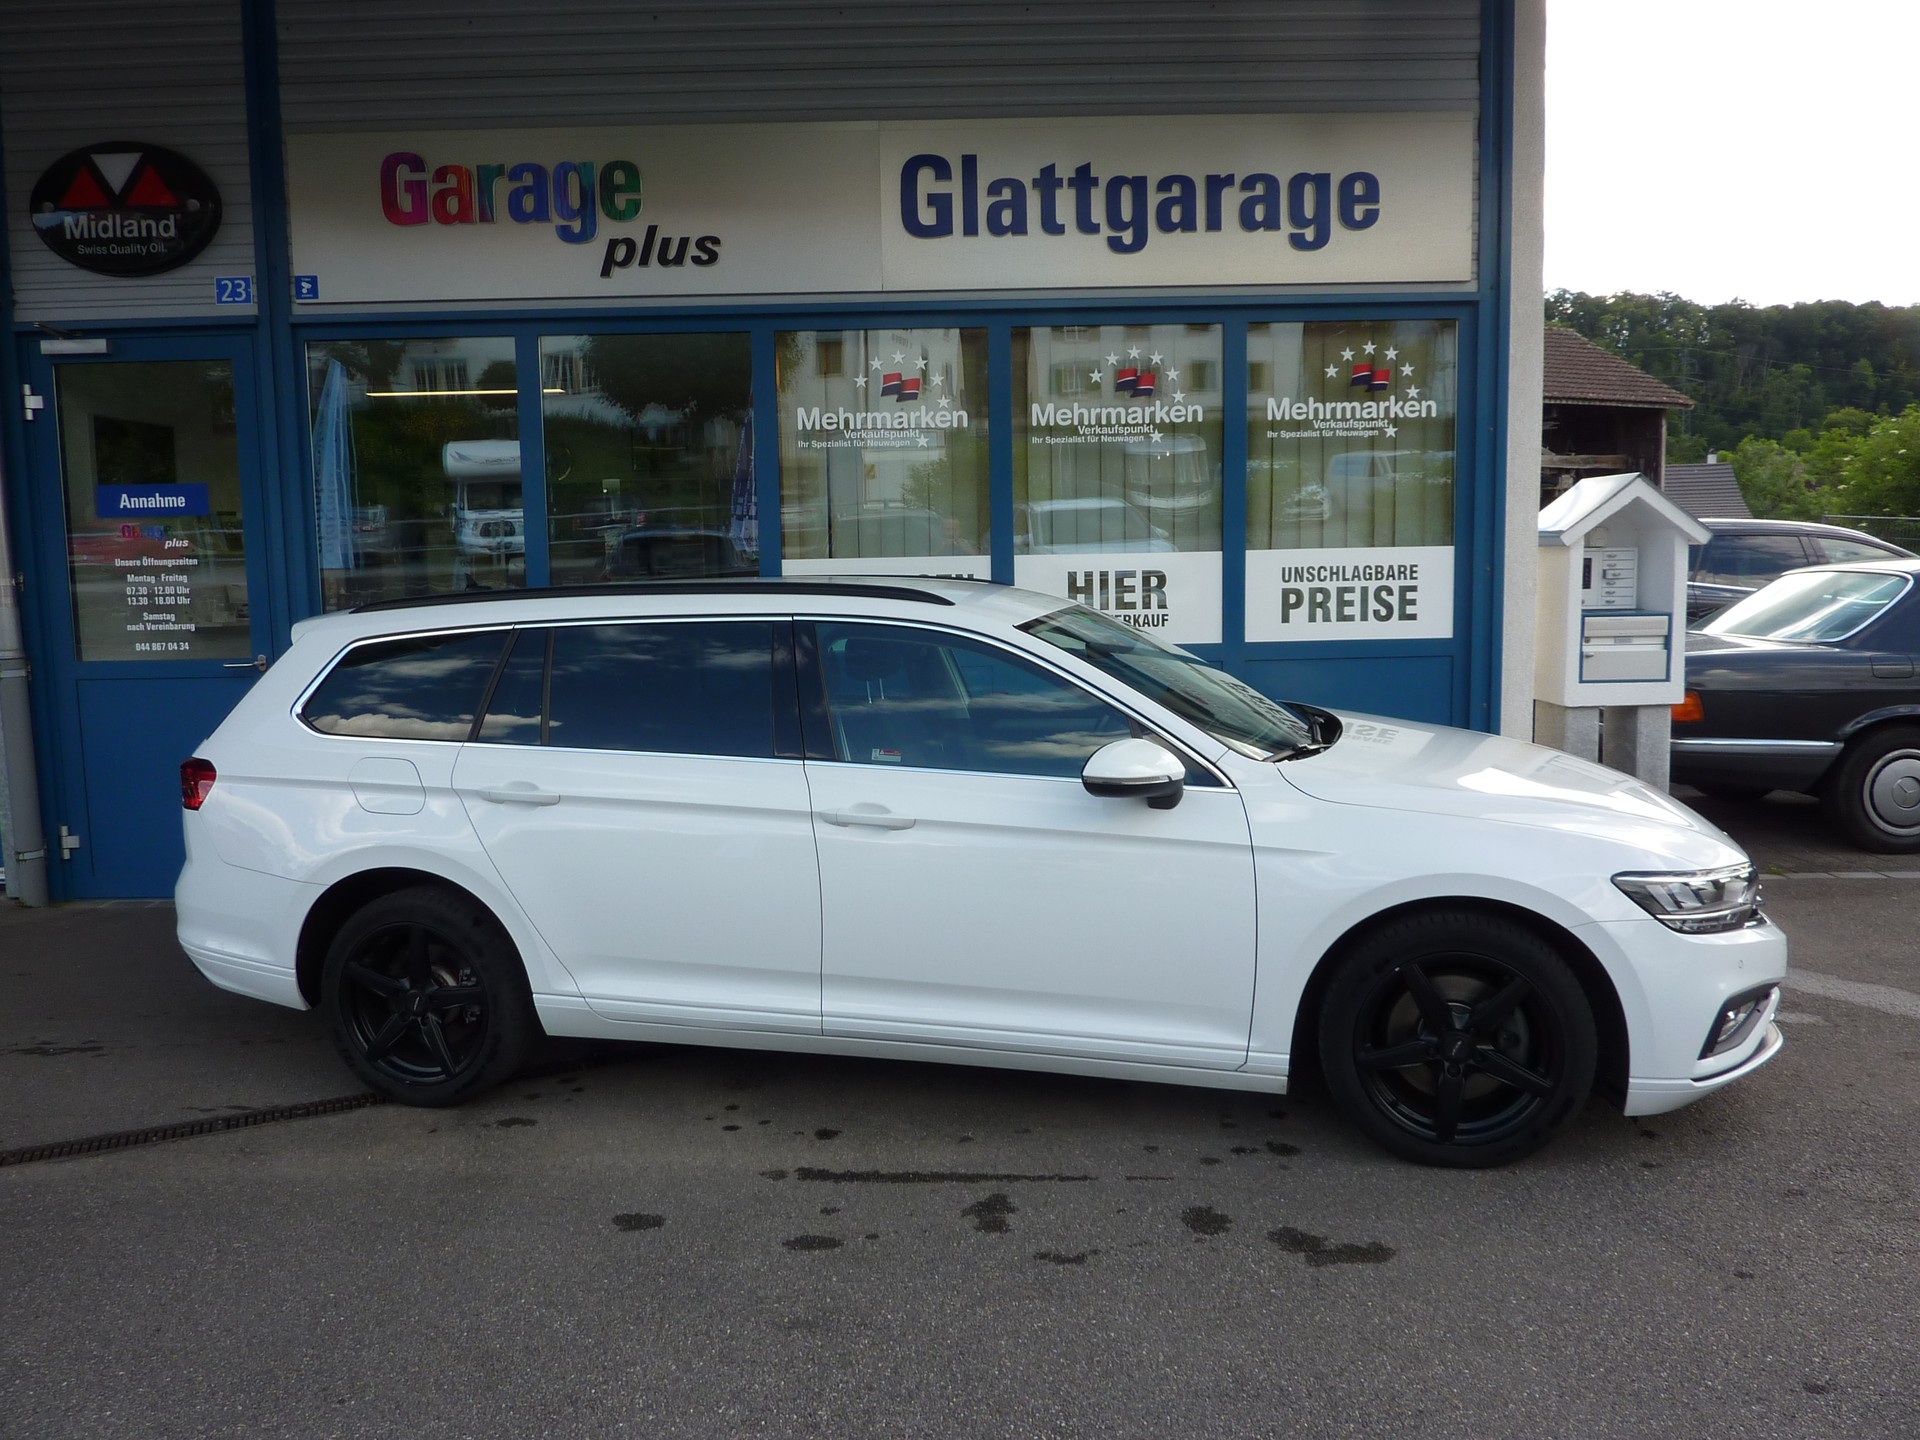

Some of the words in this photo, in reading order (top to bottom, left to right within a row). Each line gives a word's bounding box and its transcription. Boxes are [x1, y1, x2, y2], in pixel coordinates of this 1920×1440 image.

[380, 151, 643, 244] Garage
[899, 153, 1380, 254] Glattgarage
[63, 213, 176, 240] Midland
[77, 244, 108, 255] Swiss
[109, 243, 147, 255] Quality
[600, 224, 722, 279] plus
[221, 279, 247, 302] 23
[1031, 400, 1203, 426] Mehrmarken
[1266, 395, 1437, 421] Mehrmarken
[796, 405, 969, 431] Mehrmarken
[1313, 418, 1389, 430] Verkaufspunkt
[843, 429, 920, 440] Verkaufspunkt
[1077, 424, 1154, 435] Verkaufspunkt
[1267, 430, 1279, 438] Ihr
[1280, 430, 1321, 439] Spezialist
[1322, 429, 1334, 437] für
[1336, 429, 1379, 438] Neuwagen
[798, 440, 810, 448] Ihr
[811, 440, 852, 449] Spezialist
[853, 439, 865, 447] für
[867, 439, 910, 448] Neuwagen
[1031, 436, 1043, 444] Ihr
[1045, 435, 1085, 444] Spezialist
[1087, 435, 1099, 443] für
[1101, 435, 1144, 443] Neuwagen
[119, 493, 186, 509] Annahme
[164, 538, 189, 549] plus
[115, 558, 141, 567] Unsere
[142, 556, 198, 567] Öffnungszeiten
[127, 574, 156, 584] Montag
[161, 573, 188, 583] Freitag
[1281, 564, 1419, 583] UNSCHLAGBARE
[126, 586, 148, 595] 07.30
[154, 586, 175, 594] 12.00
[176, 586, 190, 594] Uhr
[1067, 569, 1168, 610] HIER
[127, 596, 148, 605] 13.30
[155, 596, 175, 605] 18.00
[177, 596, 191, 604] Uhr
[1281, 585, 1418, 624] PREISE
[143, 612, 175, 621] Samstag
[127, 622, 145, 631] nach
[146, 622, 195, 631] Vereinbarung
[135, 642, 150, 651] 044
[168, 642, 177, 650] 04
[179, 642, 189, 650] 34
